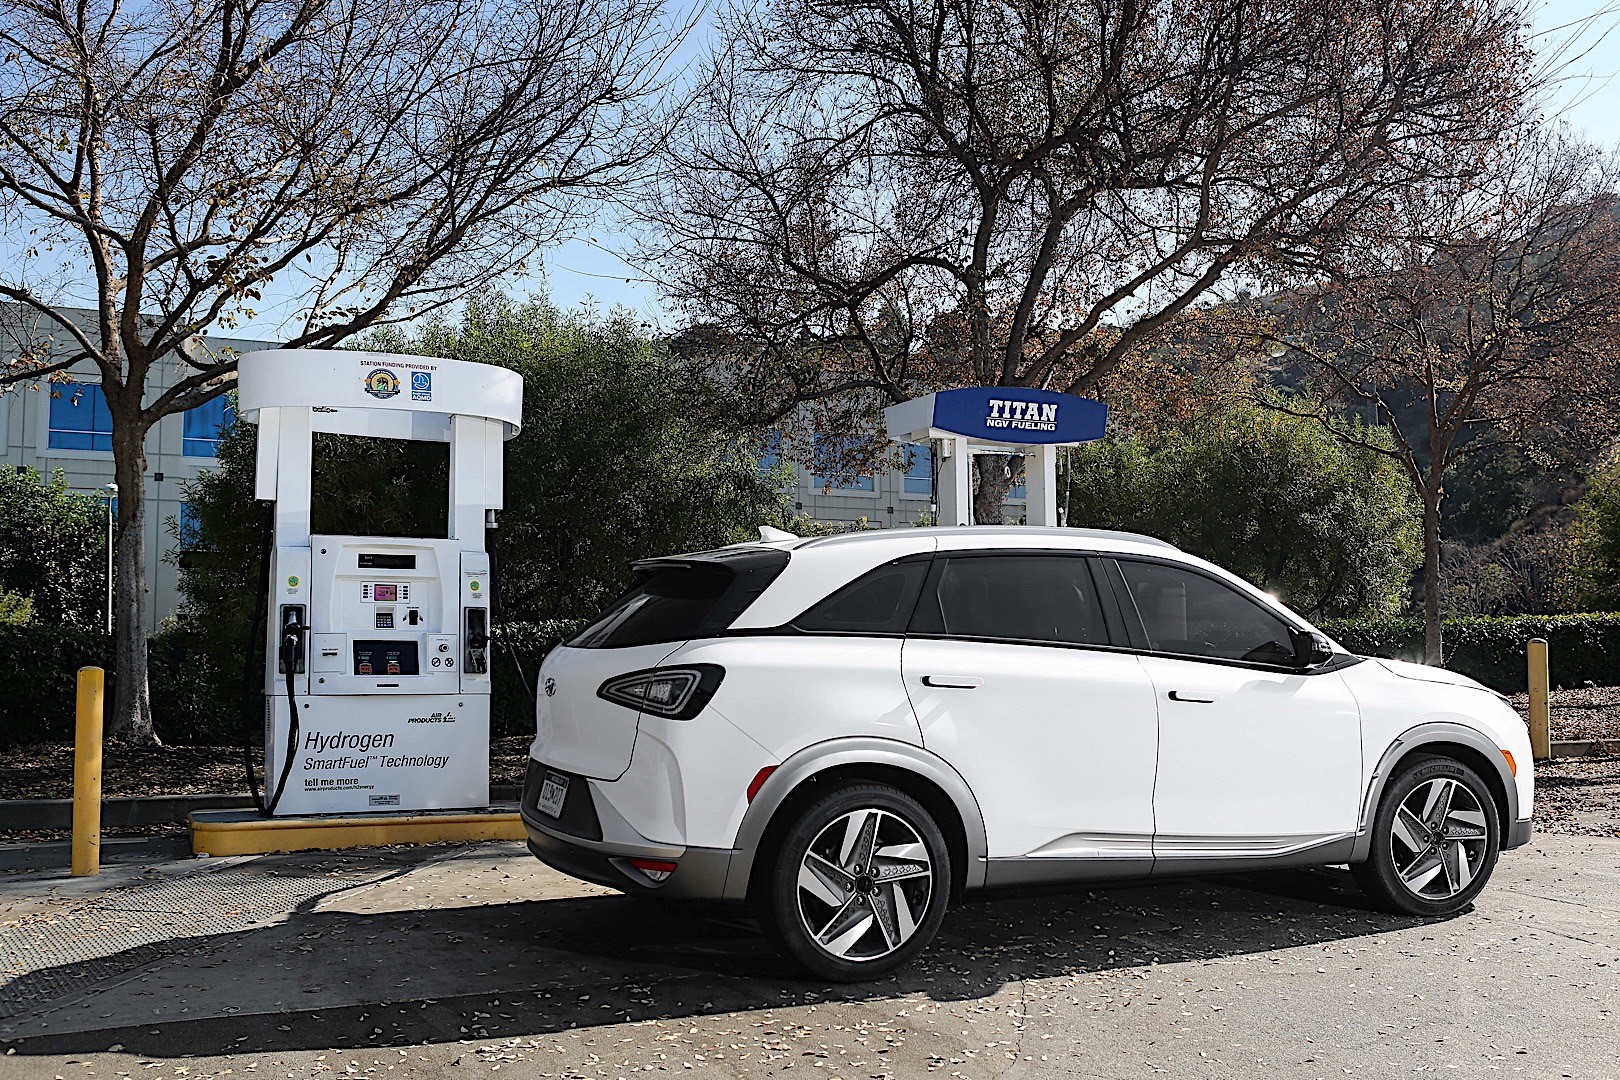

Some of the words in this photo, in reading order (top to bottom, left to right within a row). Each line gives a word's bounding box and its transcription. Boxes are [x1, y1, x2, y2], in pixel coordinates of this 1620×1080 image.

[989, 400, 1057, 421] TITAN
[987, 419, 1009, 428] NGV
[1012, 421, 1056, 431] FUELING
[304, 731, 395, 753] Hydrogen
[380, 754, 450, 768] Technology
[304, 778, 318, 787] tell
